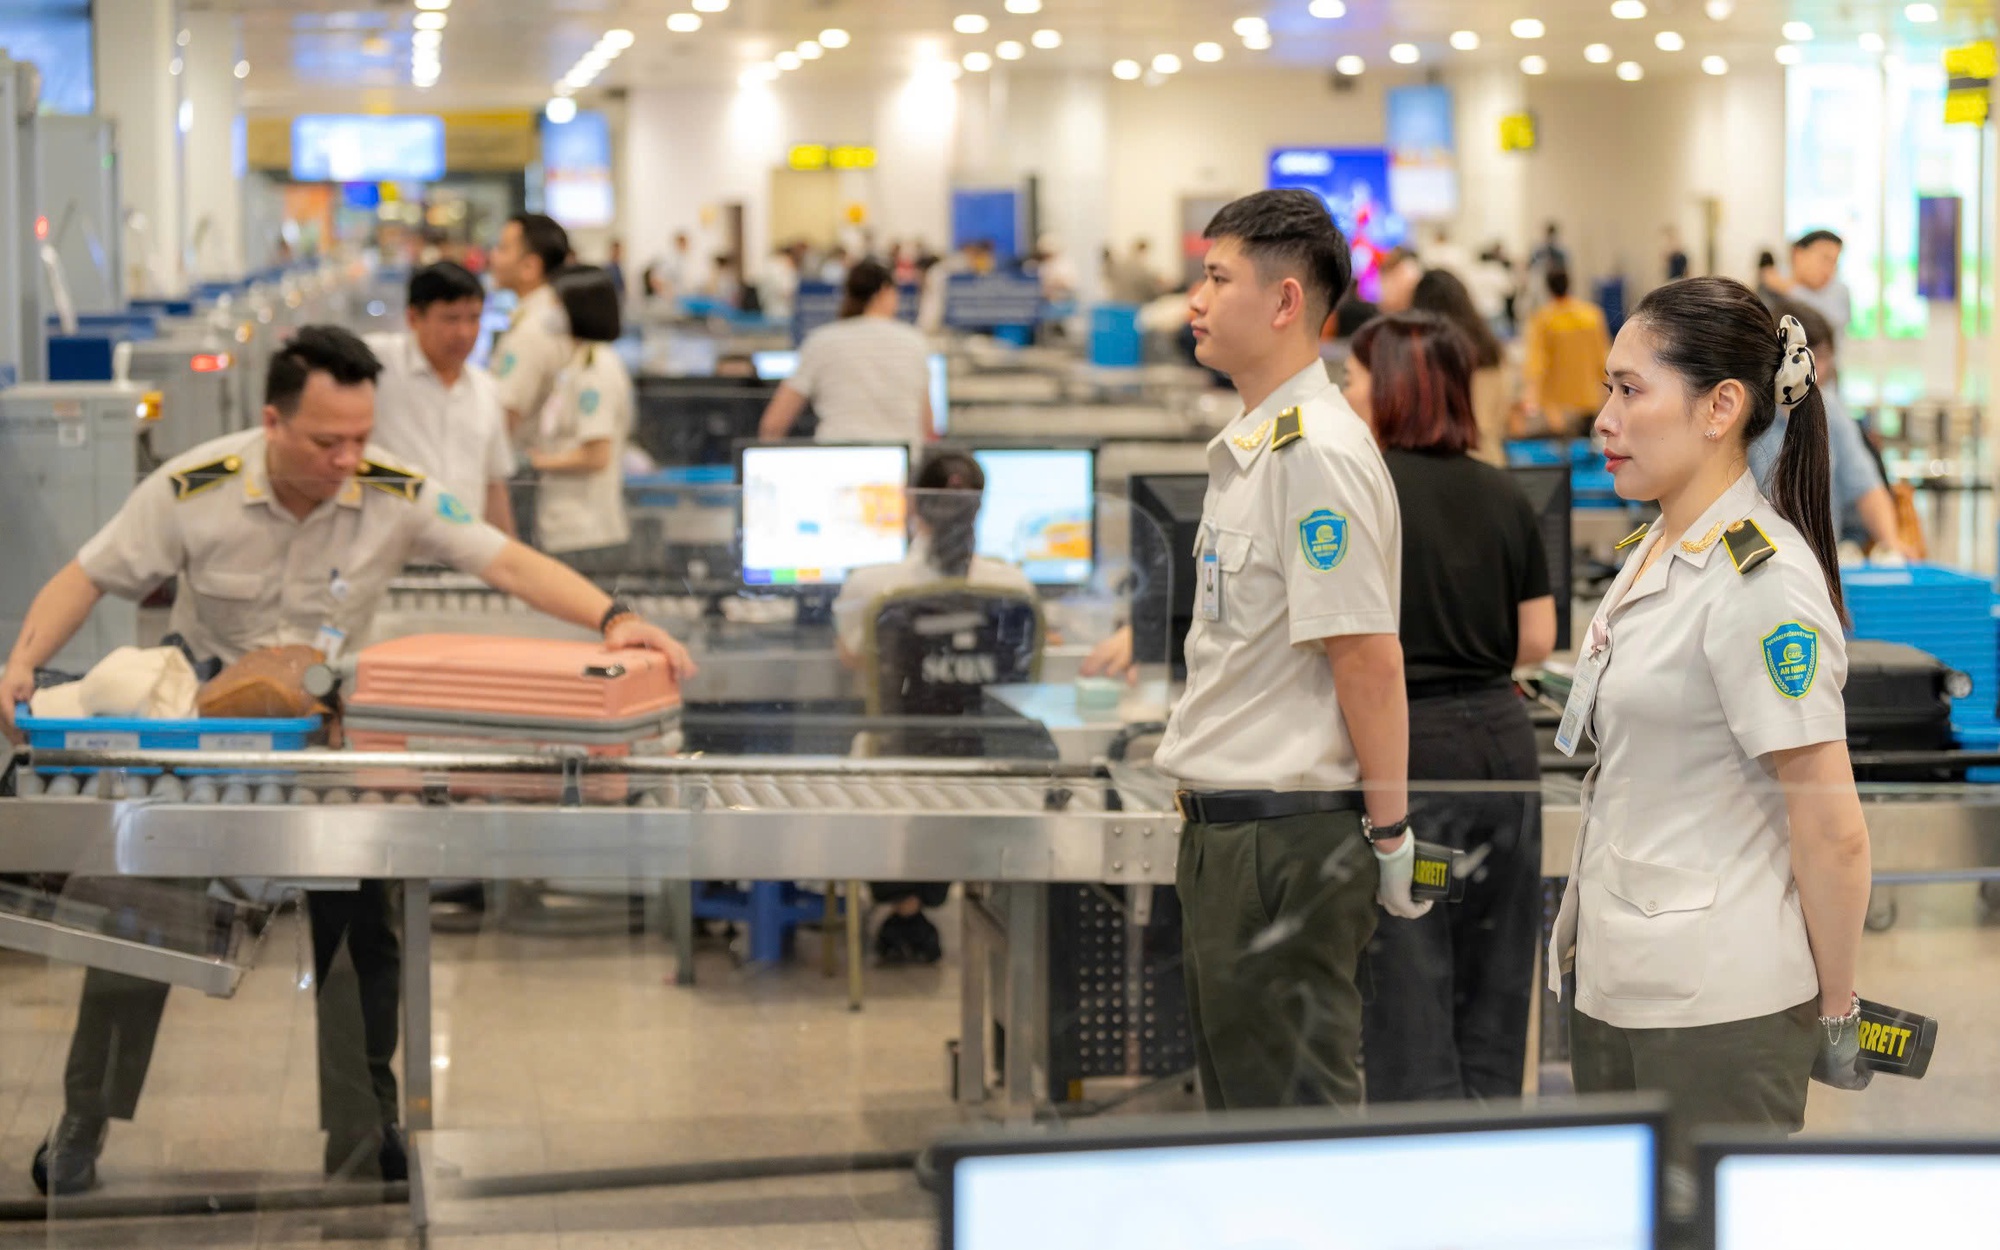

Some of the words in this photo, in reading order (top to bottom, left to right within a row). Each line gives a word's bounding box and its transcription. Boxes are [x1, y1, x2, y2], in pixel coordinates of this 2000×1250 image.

[1780, 666, 1790, 675] AN
[1414, 860, 1447, 887] ARRETT
[1859, 1021, 1911, 1057] RRETT
